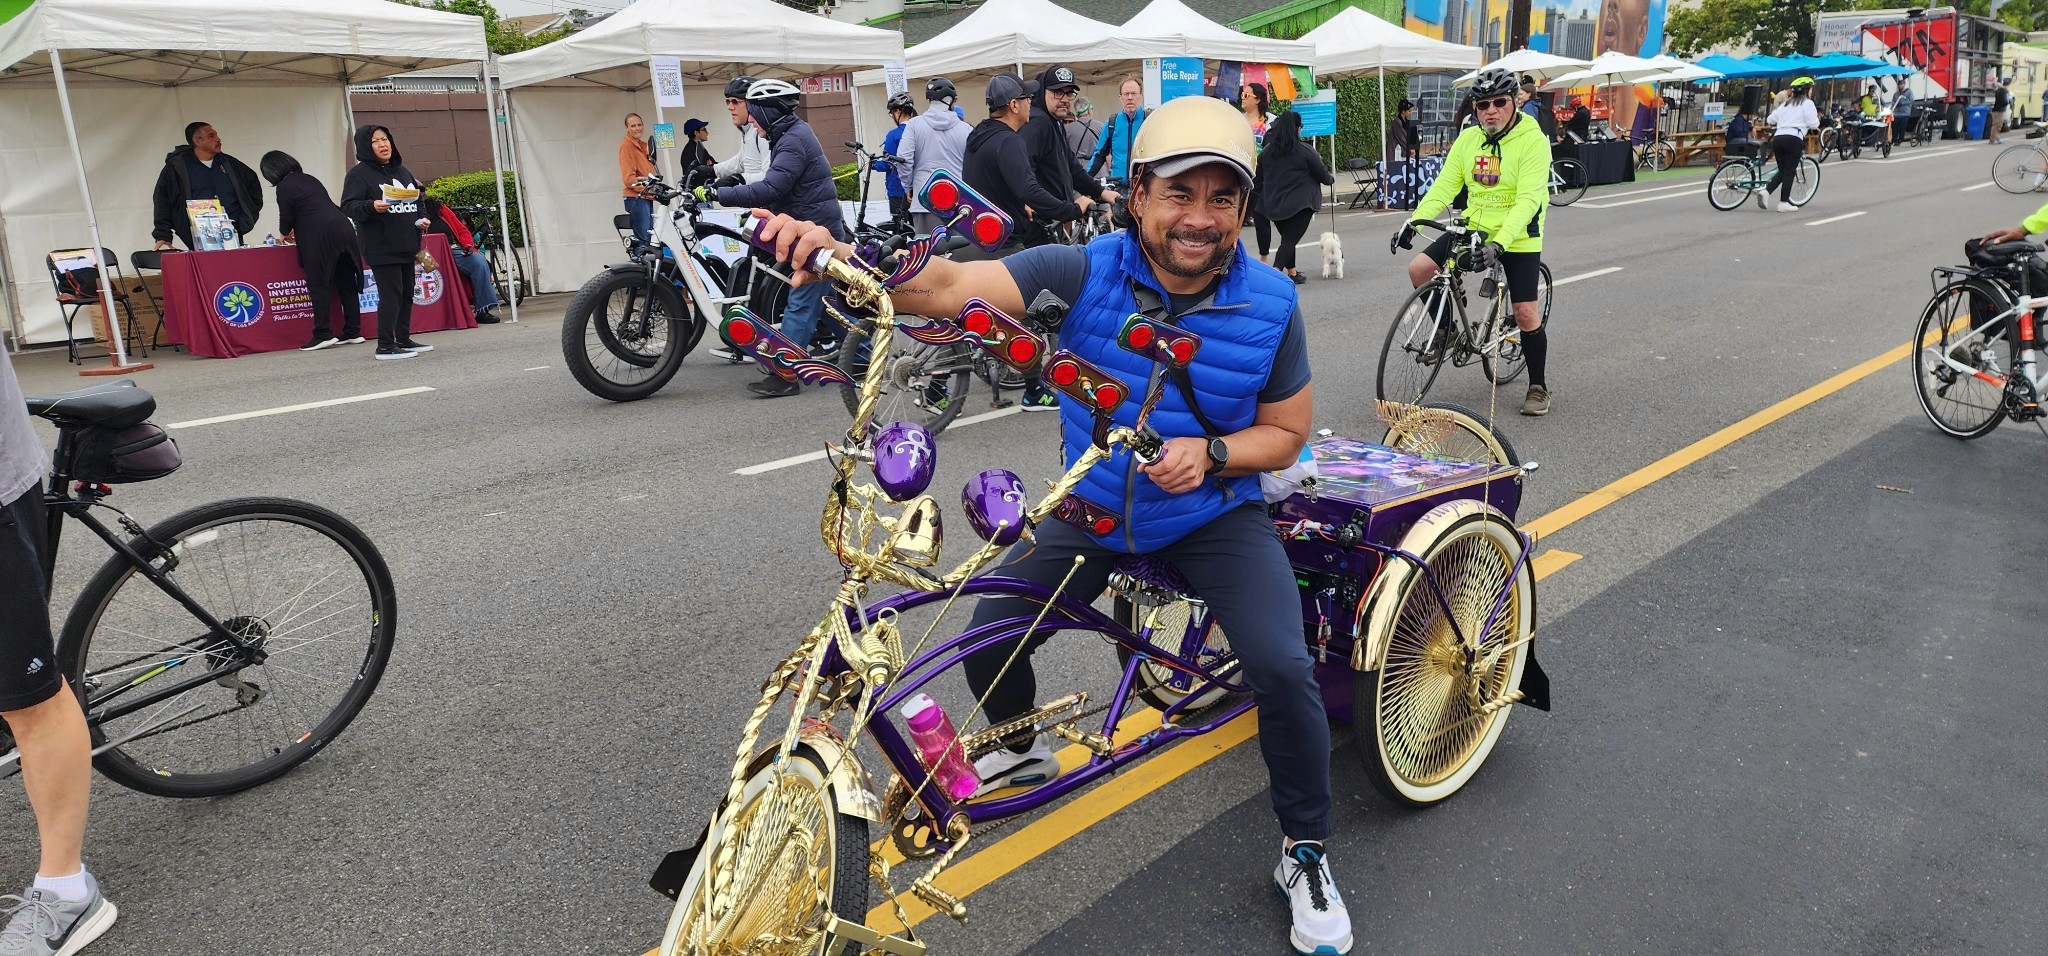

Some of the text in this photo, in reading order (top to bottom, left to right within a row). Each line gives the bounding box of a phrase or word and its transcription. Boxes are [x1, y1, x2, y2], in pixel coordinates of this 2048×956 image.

[1162, 60, 1177, 70] Free
[1162, 71, 1199, 83] Bike Repair
[1471, 190, 1513, 201] BARCELONA
[268, 287, 310, 297] INVESTM
[269, 294, 311, 305] FOR FAMI
[218, 315, 229, 325] CITY
[247, 310, 265, 326] ANGELES
